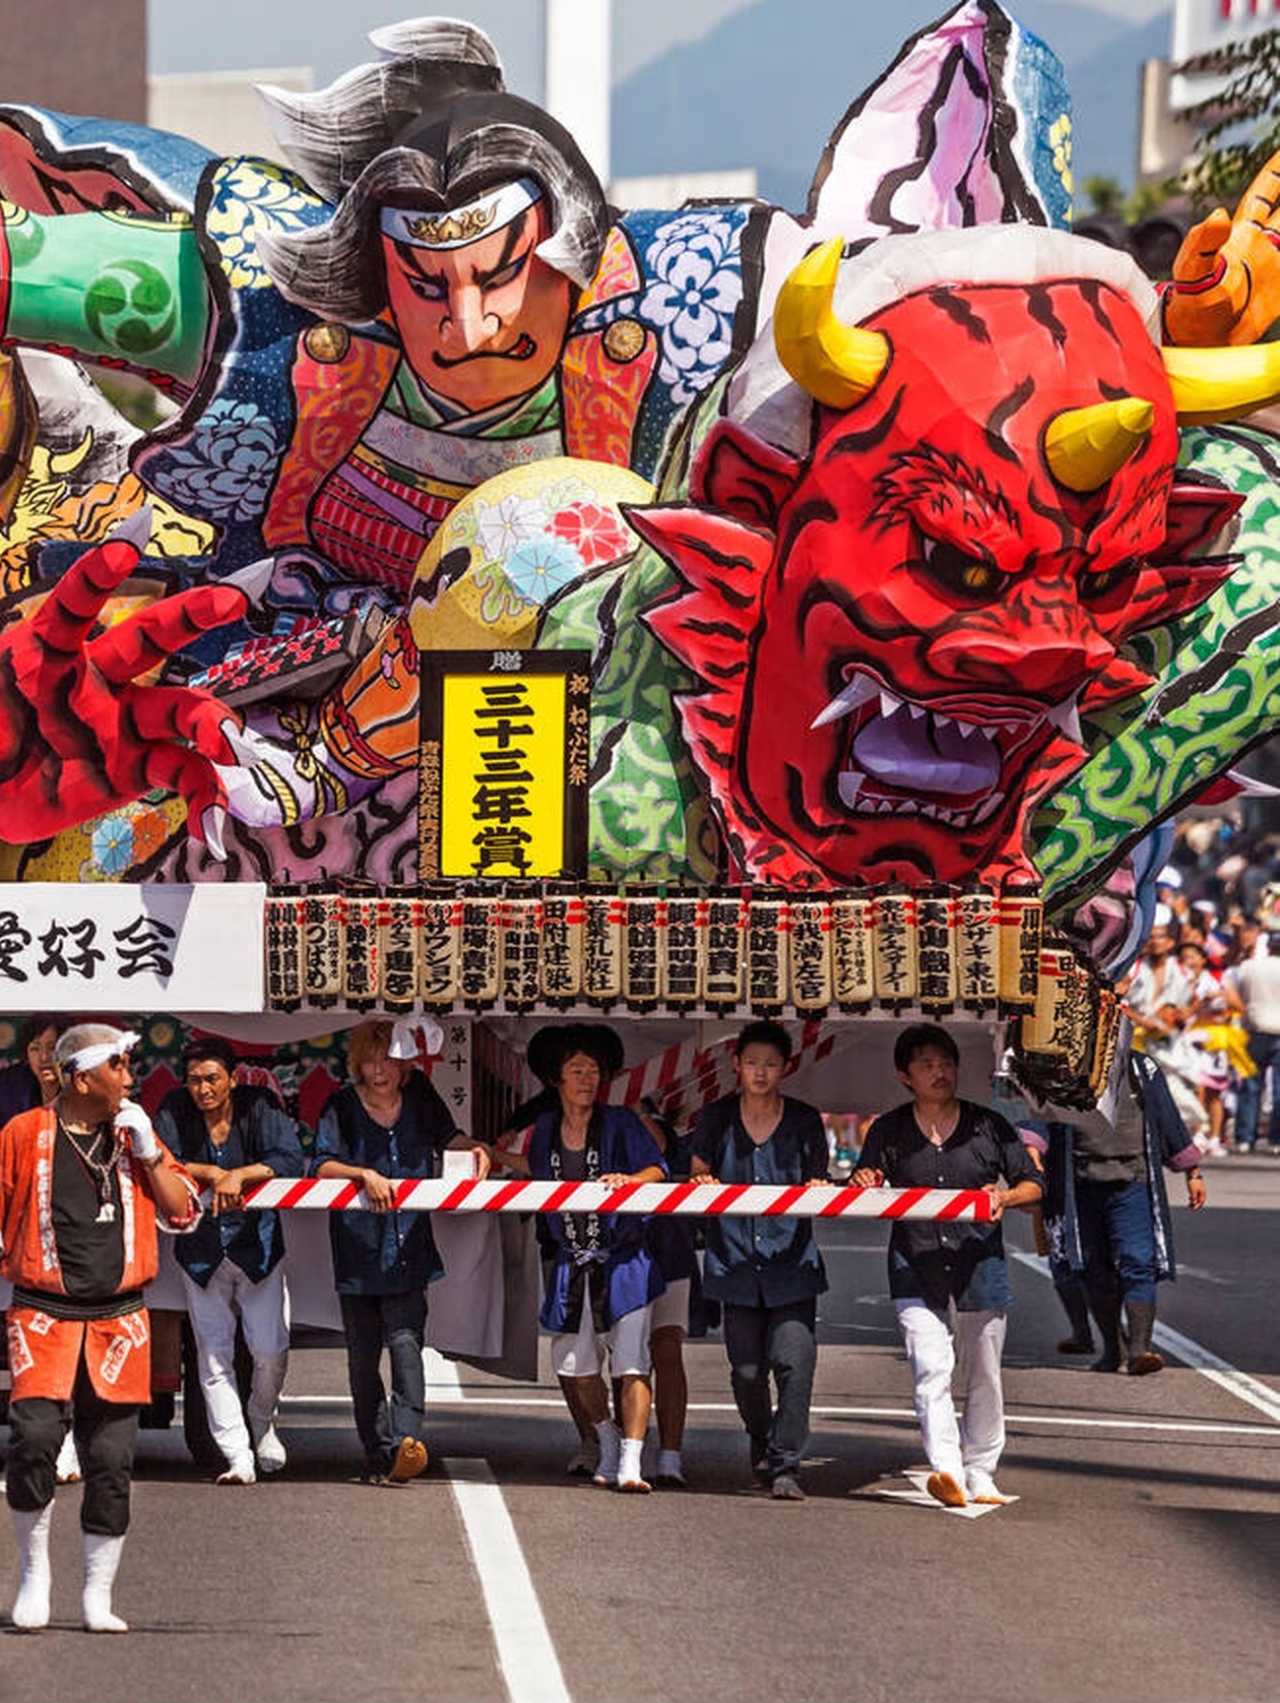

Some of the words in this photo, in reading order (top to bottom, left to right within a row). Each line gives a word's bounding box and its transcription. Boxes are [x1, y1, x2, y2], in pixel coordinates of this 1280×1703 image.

[488, 650, 523, 671] 贈
[470, 683, 535, 876] 三十三年賞
[568, 704, 590, 787] ねぶた祭
[962, 898, 996, 995] ホシザキ東北
[450, 1024, 468, 1106] 第十号
